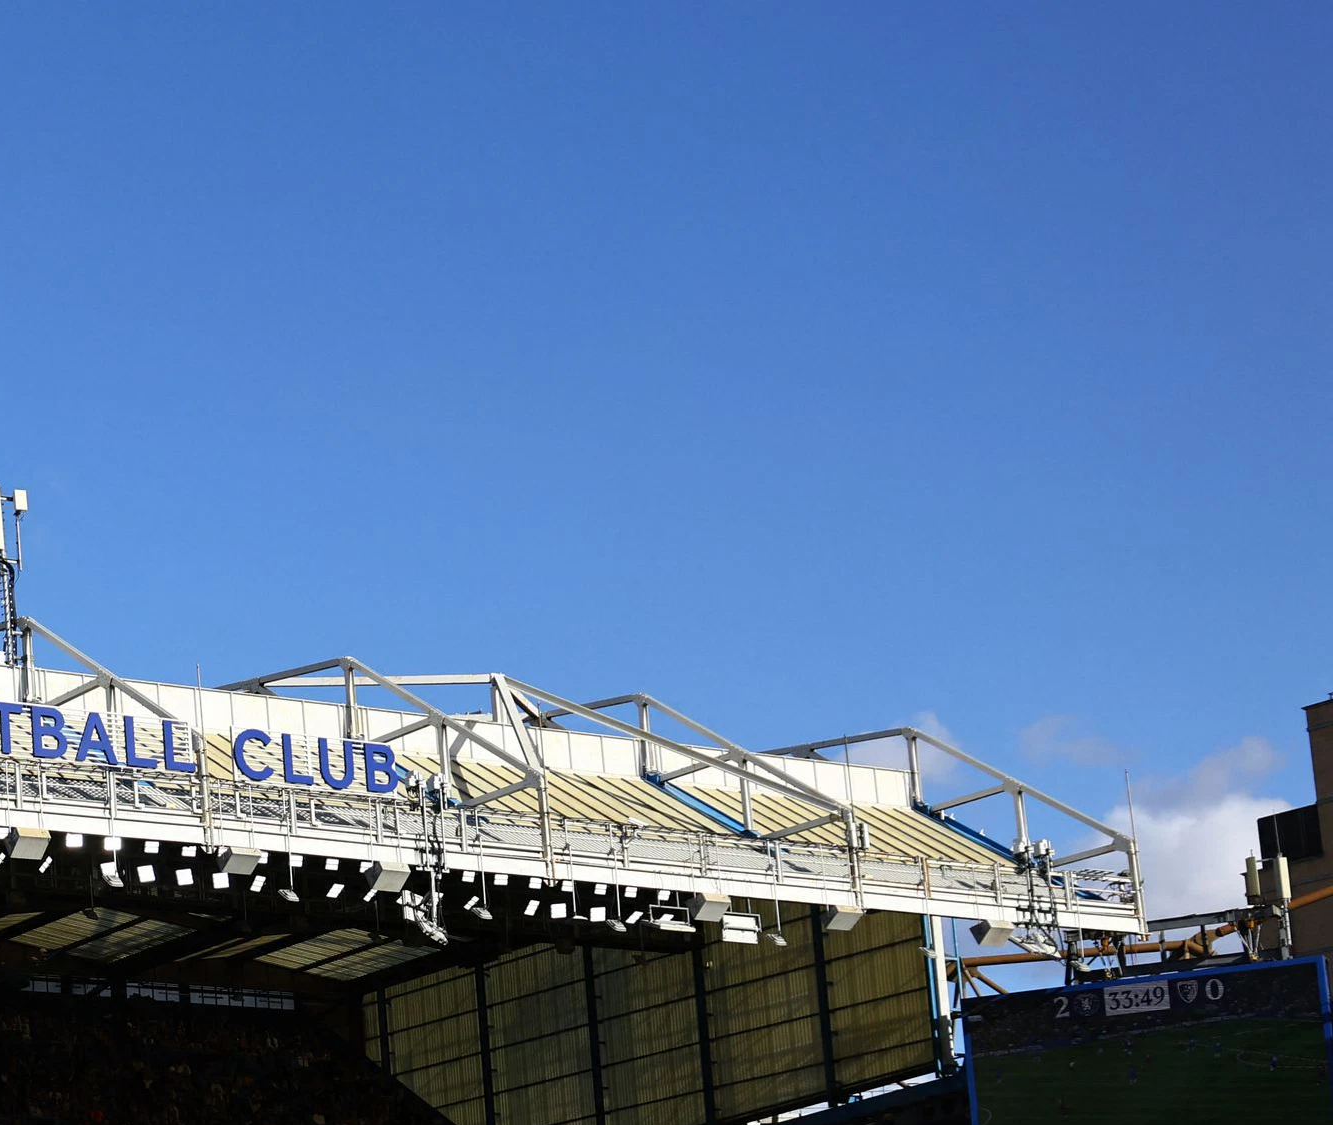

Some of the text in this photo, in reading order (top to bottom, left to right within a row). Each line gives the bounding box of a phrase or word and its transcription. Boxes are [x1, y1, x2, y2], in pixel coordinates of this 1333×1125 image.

[232, 727, 399, 795] CLUB
[1054, 978, 1224, 1019] 2 33:49 0
